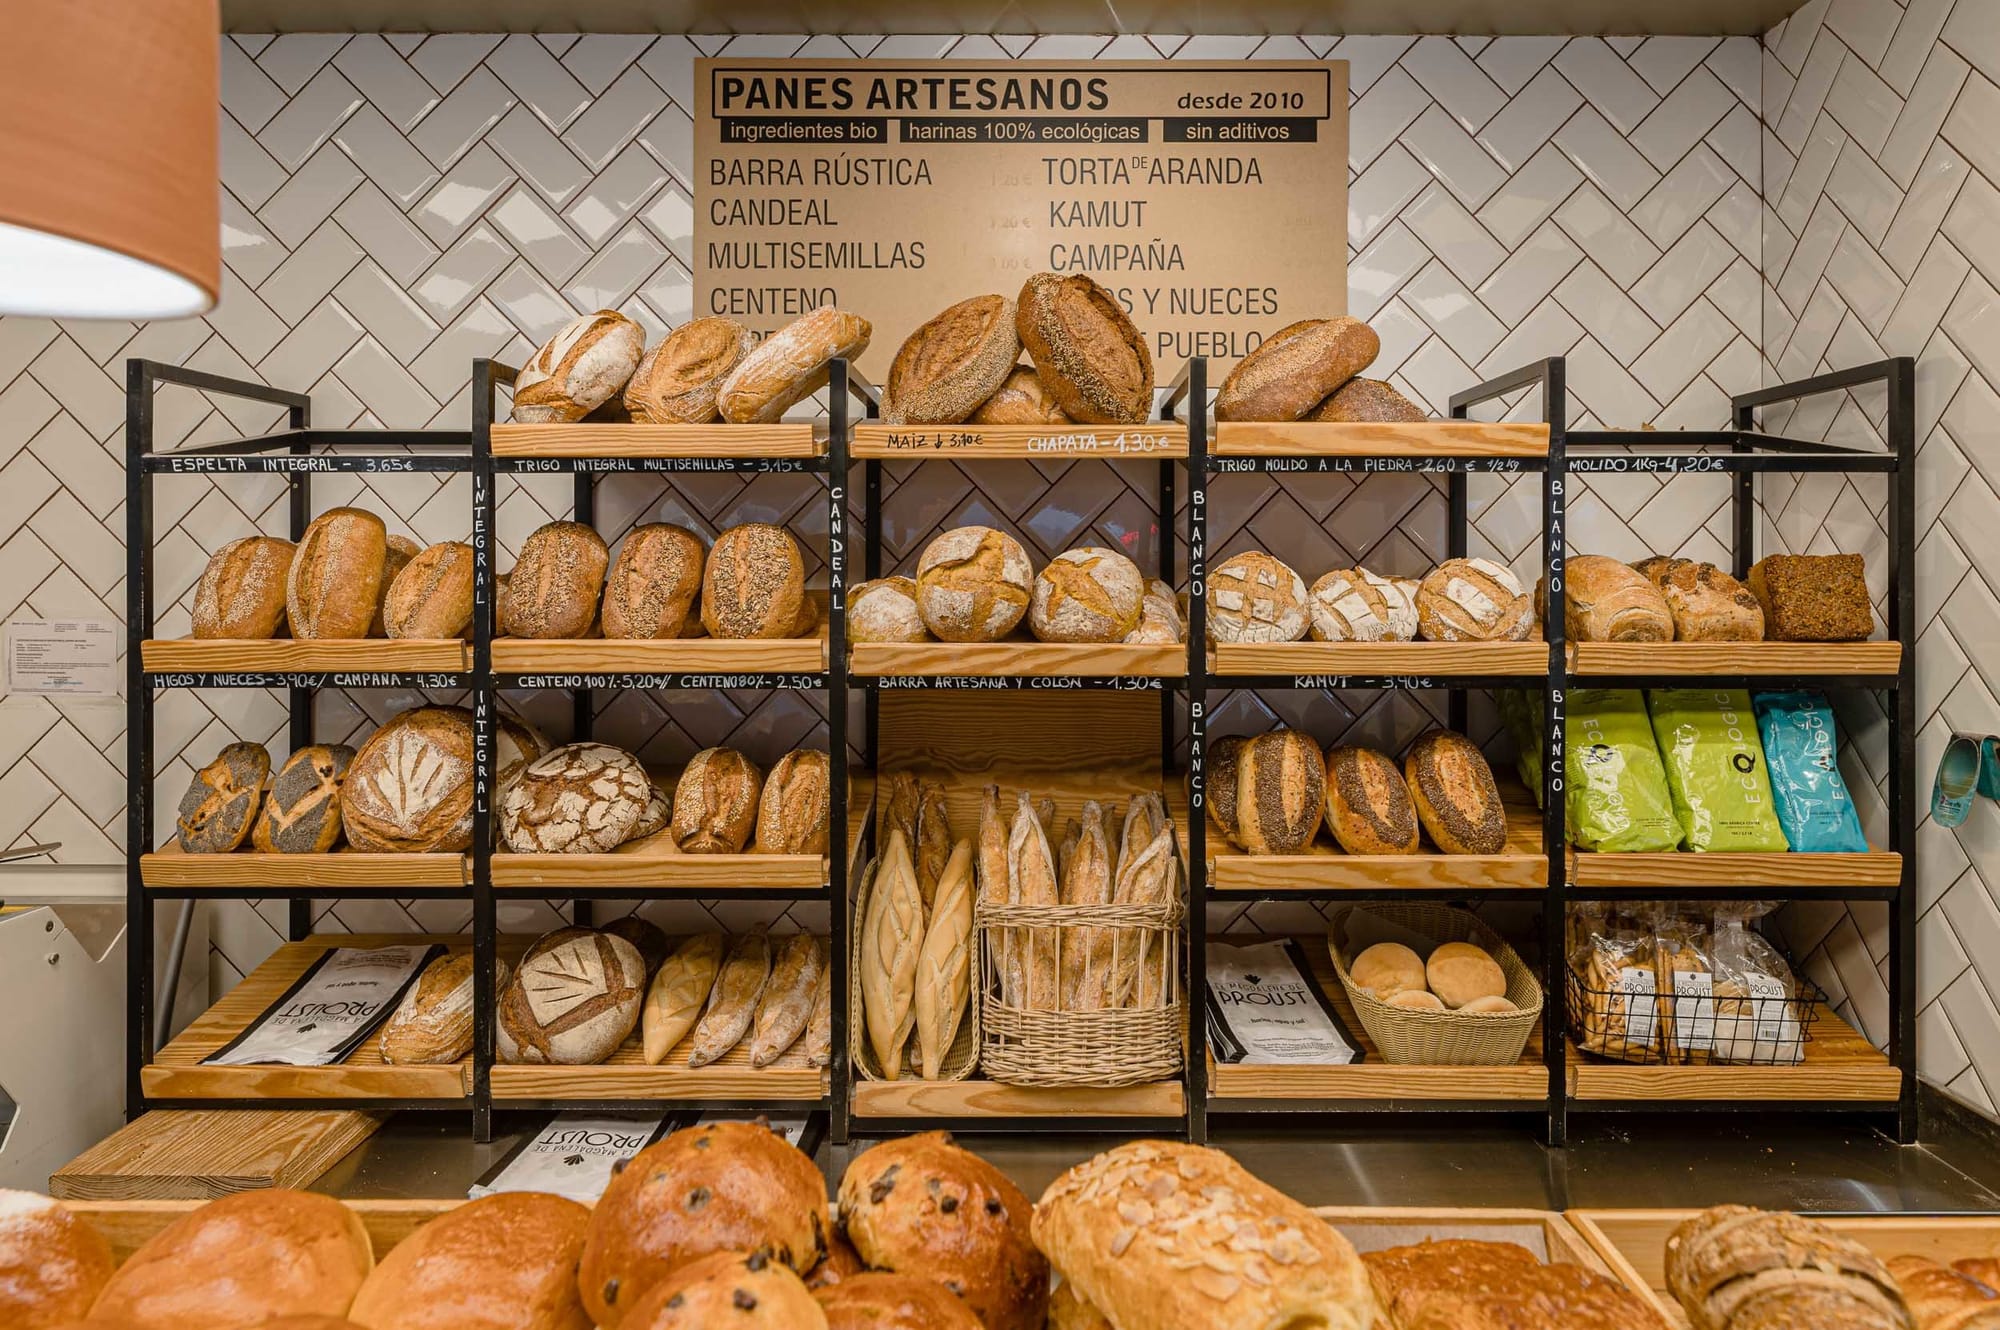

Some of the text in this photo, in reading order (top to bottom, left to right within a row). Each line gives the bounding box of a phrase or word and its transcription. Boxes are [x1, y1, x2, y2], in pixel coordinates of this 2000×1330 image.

[722, 77, 1109, 111] PANES ARTESANOS
[1177, 92, 1304, 110] desde 2010
[730, 121, 878, 142] ingredientes bio
[909, 121, 1141, 143] harinas 100% ecológicas
[1185, 121, 1290, 140] sin aditivos
[710, 151, 933, 186] BARRA RÚSTICA
[1041, 156, 1263, 186] TORTA DE ARANDA
[709, 198, 839, 227] CANDEAL
[1049, 200, 1148, 229] KAMUT
[707, 241, 926, 270] MULTISEMILLAS
[1049, 237, 1185, 272] CAMPAÑA
[709, 286, 838, 316] CENTENO
[1142, 287, 1161, 315] Y
[1169, 287, 1279, 316] NUECES
[1157, 331, 1263, 359] PUEBLO
[1027, 434, 1097, 453] CHAPATA
[171, 457, 247, 472] ESPELTA
[263, 457, 338, 472] INTEGRAL
[514, 459, 561, 473] TRIGO
[573, 458, 636, 471] INTEGRAL
[643, 457, 735, 471] MULTISEMILLAS
[1217, 458, 1256, 472] TRIGO
[1265, 458, 1308, 472] MOLIDO
[1318, 459, 1329, 471] A
[1335, 459, 1353, 471] LA
[1569, 457, 1628, 472] MOLIDO
[474, 475, 486, 604] INTEGRAL
[1191, 490, 1205, 597] BLANCO
[1550, 480, 1564, 593] BLANCO
[830, 486, 844, 611] CANDEAL
[153, 673, 194, 688] HIGOS
[198, 673, 206, 687] Y
[518, 675, 581, 688] CENTENO
[878, 675, 928, 689] BARRA
[935, 675, 1009, 689] ARTESANA
[1015, 676, 1023, 689] Y
[1294, 674, 1352, 689] KAMUT
[475, 690, 487, 813] INTEGRAL
[1550, 689, 1564, 792] BLANCO
[1191, 702, 1204, 808] BLANCO
[1217, 990, 1308, 1006] PROUST
[1750, 984, 1784, 996] PROUST
[278, 1001, 381, 1018] PROUST
[539, 1130, 646, 1150] PROUST
[554, 1145, 617, 1157] MAGDALENA
